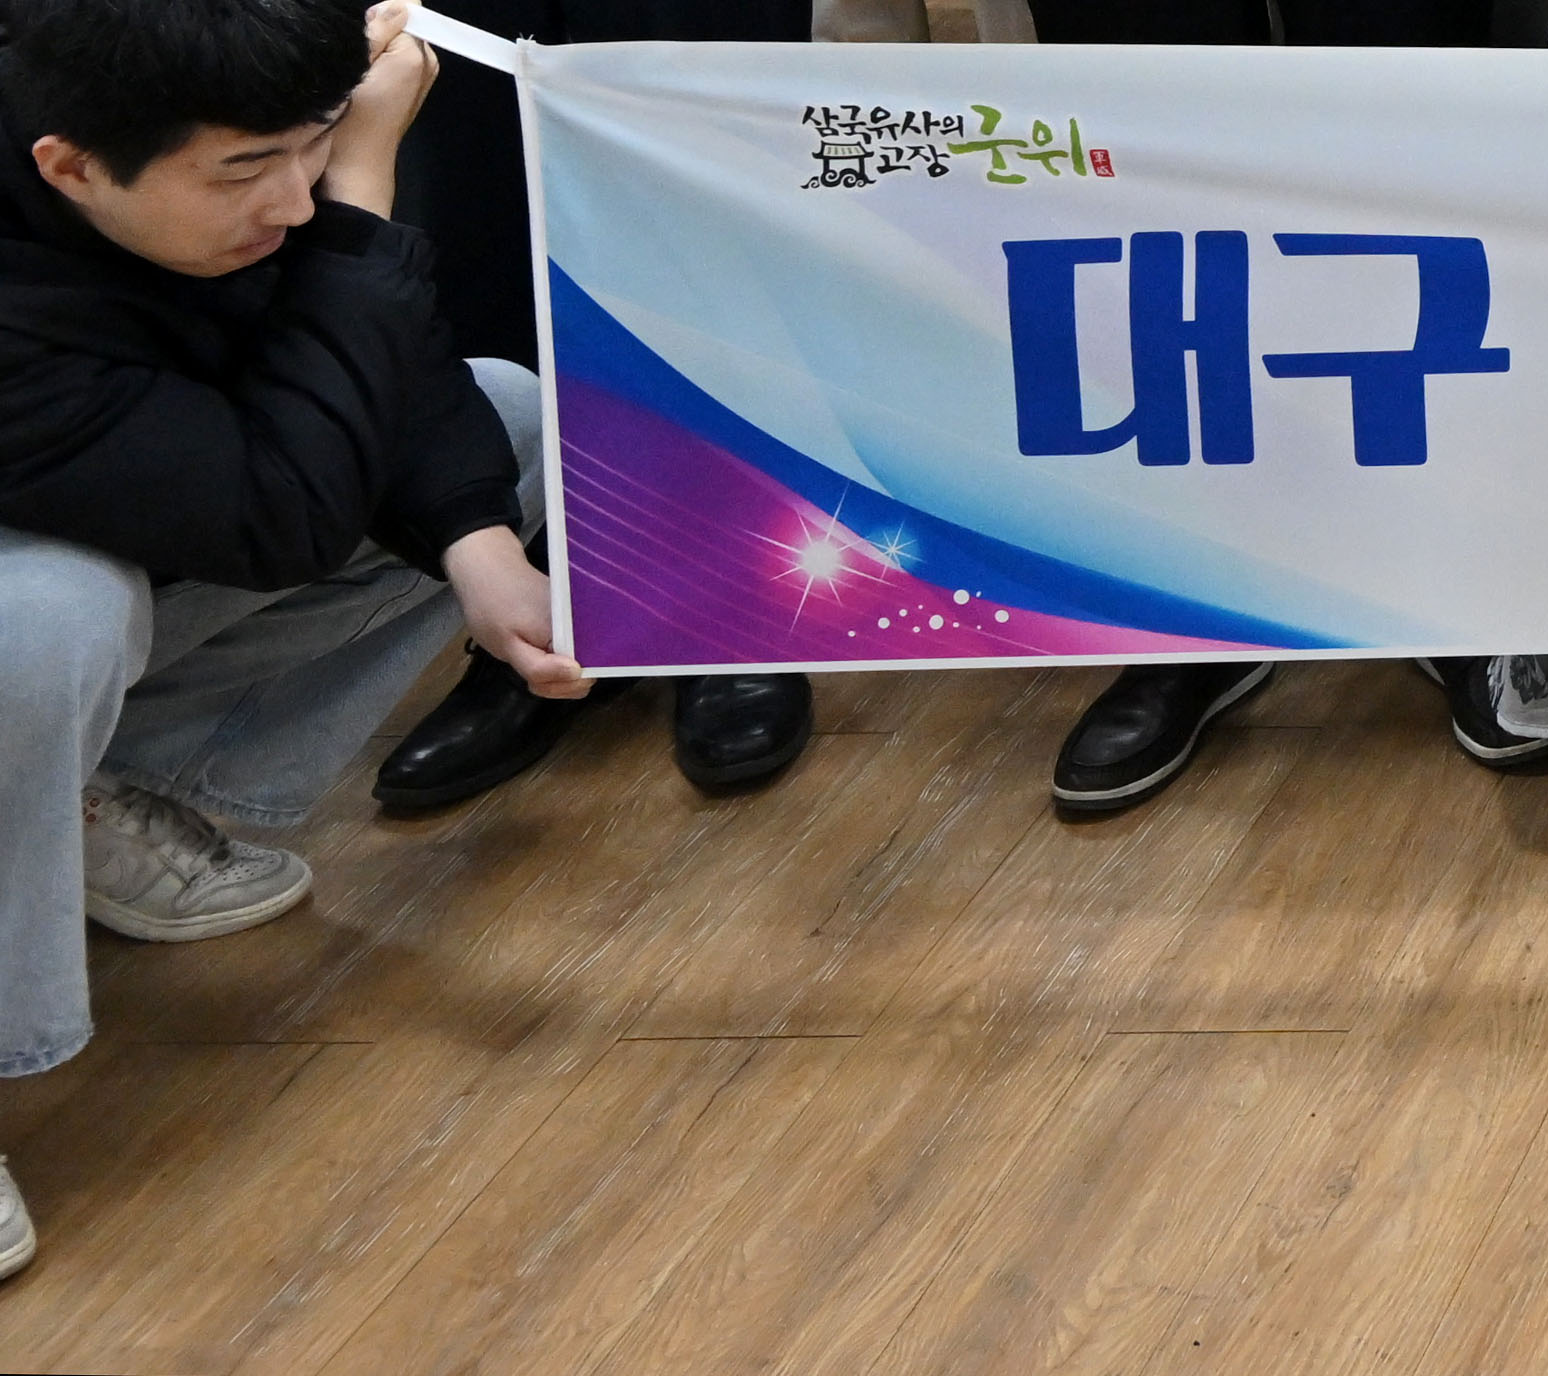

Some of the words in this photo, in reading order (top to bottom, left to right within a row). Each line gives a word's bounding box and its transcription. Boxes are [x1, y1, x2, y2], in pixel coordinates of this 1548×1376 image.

[801, 104, 965, 145] 삼국유사의
[947, 103, 1089, 186] 군위
[876, 144, 951, 179] 고장
[1001, 228, 1511, 469] 대구
